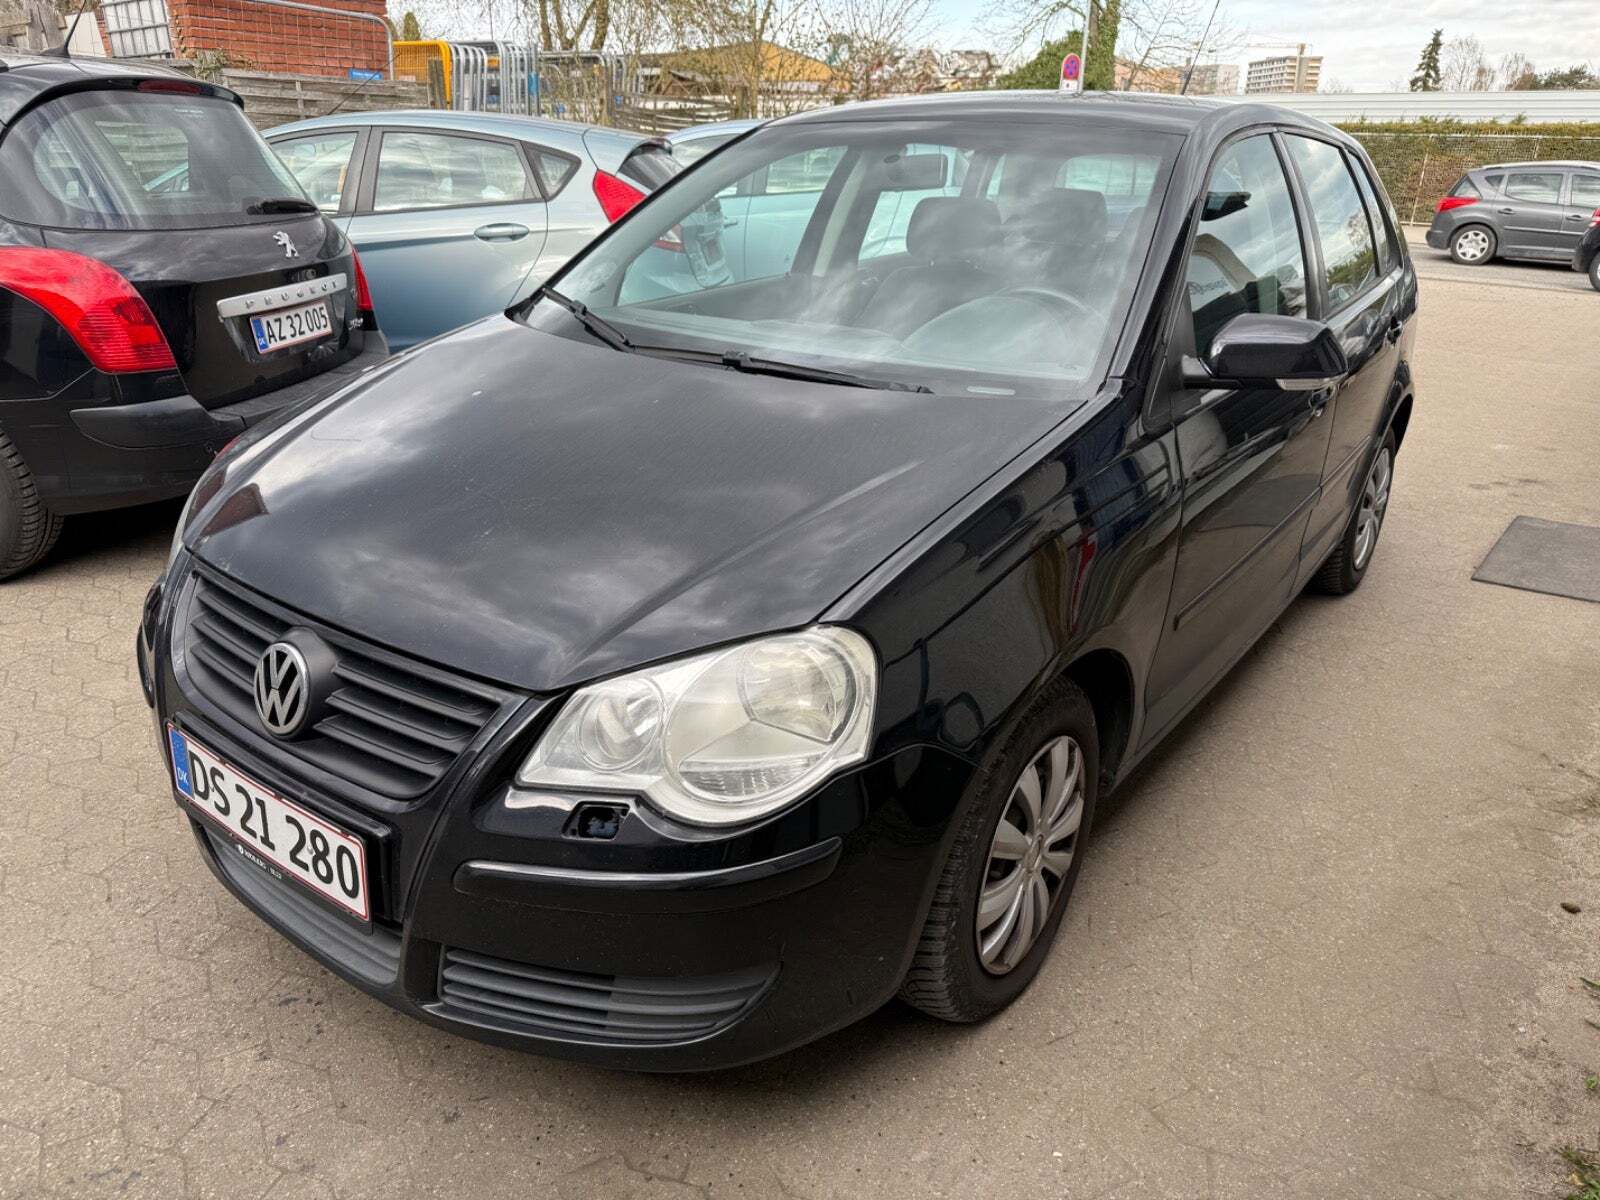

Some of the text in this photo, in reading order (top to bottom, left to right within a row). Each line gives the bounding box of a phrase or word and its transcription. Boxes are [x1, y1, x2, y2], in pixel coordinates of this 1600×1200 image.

[265, 317, 287, 344] AZ
[286, 313, 306, 338] 32
[305, 306, 328, 332] 005
[255, 644, 307, 732] VW
[176, 767, 189, 786] DK
[188, 750, 231, 817] DS
[235, 783, 276, 851] 21
[286, 815, 360, 899] 280
